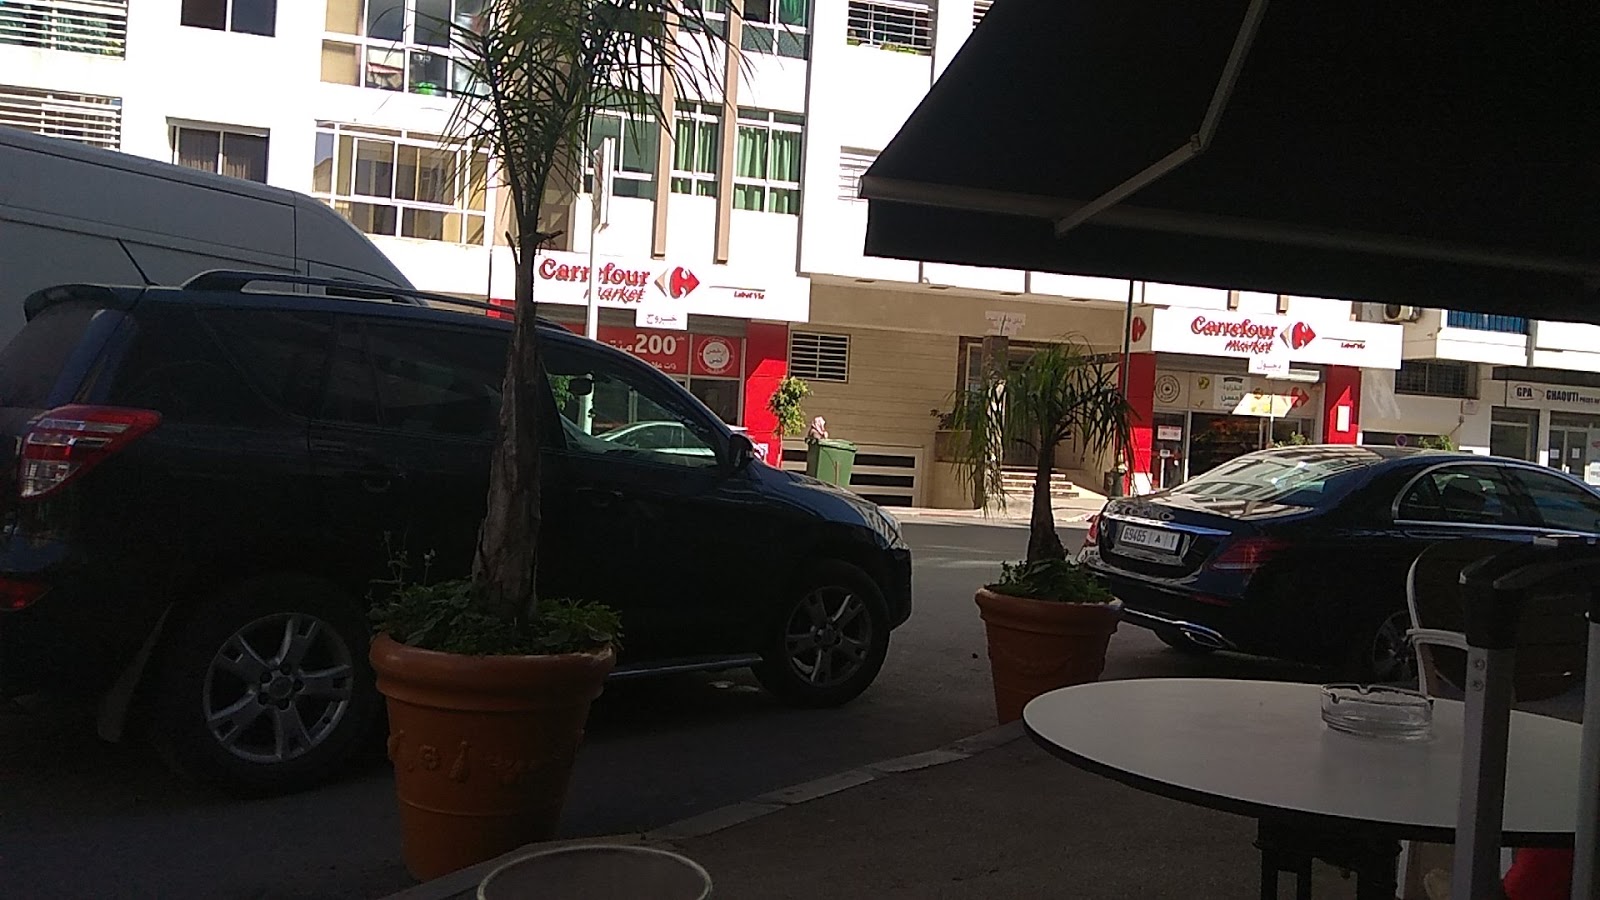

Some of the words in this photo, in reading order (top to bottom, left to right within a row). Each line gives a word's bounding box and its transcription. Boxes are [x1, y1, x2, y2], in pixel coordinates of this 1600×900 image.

[538, 257, 651, 287] Carrfour
[1190, 315, 1278, 340] Carrefour
[634, 333, 677, 355] 200
[1516, 387, 1532, 397] GPA
[1546, 390, 1579, 402] GHAOUTI
